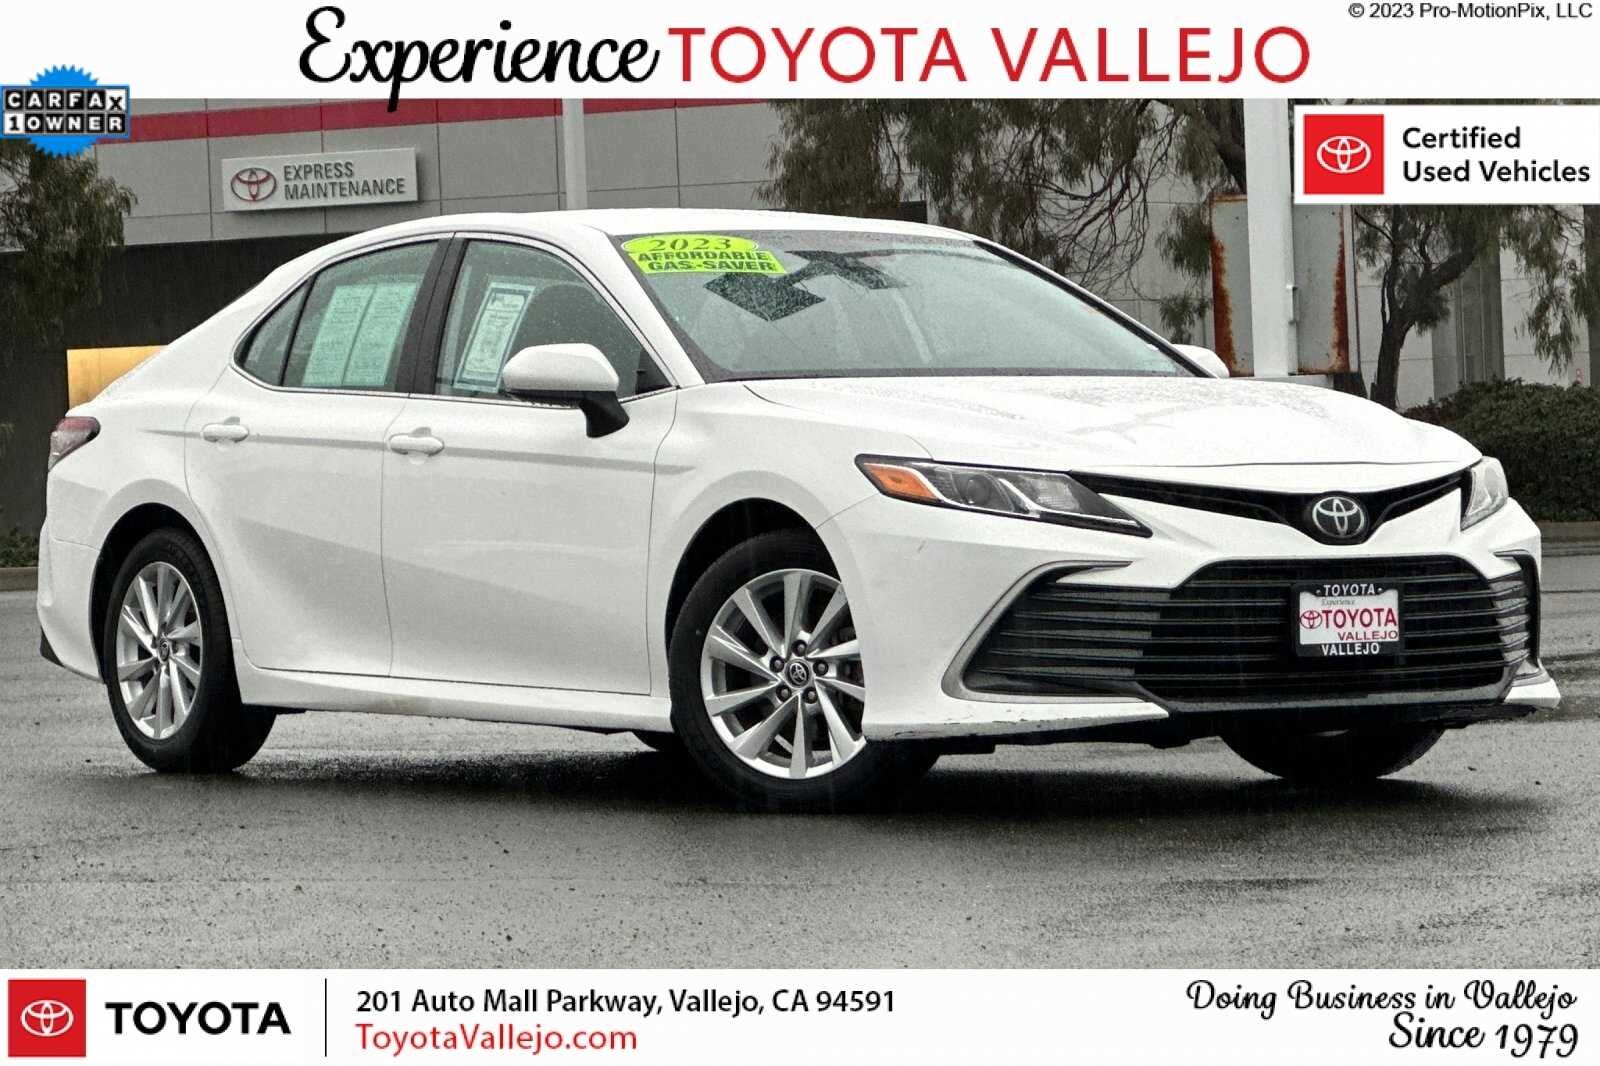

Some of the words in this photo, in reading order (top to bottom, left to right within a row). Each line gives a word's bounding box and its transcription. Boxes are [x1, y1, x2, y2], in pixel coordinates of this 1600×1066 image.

[284, 162, 354, 181] EXPRESS
[284, 178, 406, 200] MAINTENANCE
[649, 238, 731, 251] 2023
[638, 251, 770, 261] AFFORDABLE
[1323, 584, 1376, 596] TOYOTA
[1322, 608, 1398, 629] TOYOTA
[1337, 630, 1398, 641] VALLEJO
[1321, 642, 1380, 656] VALLEJO
